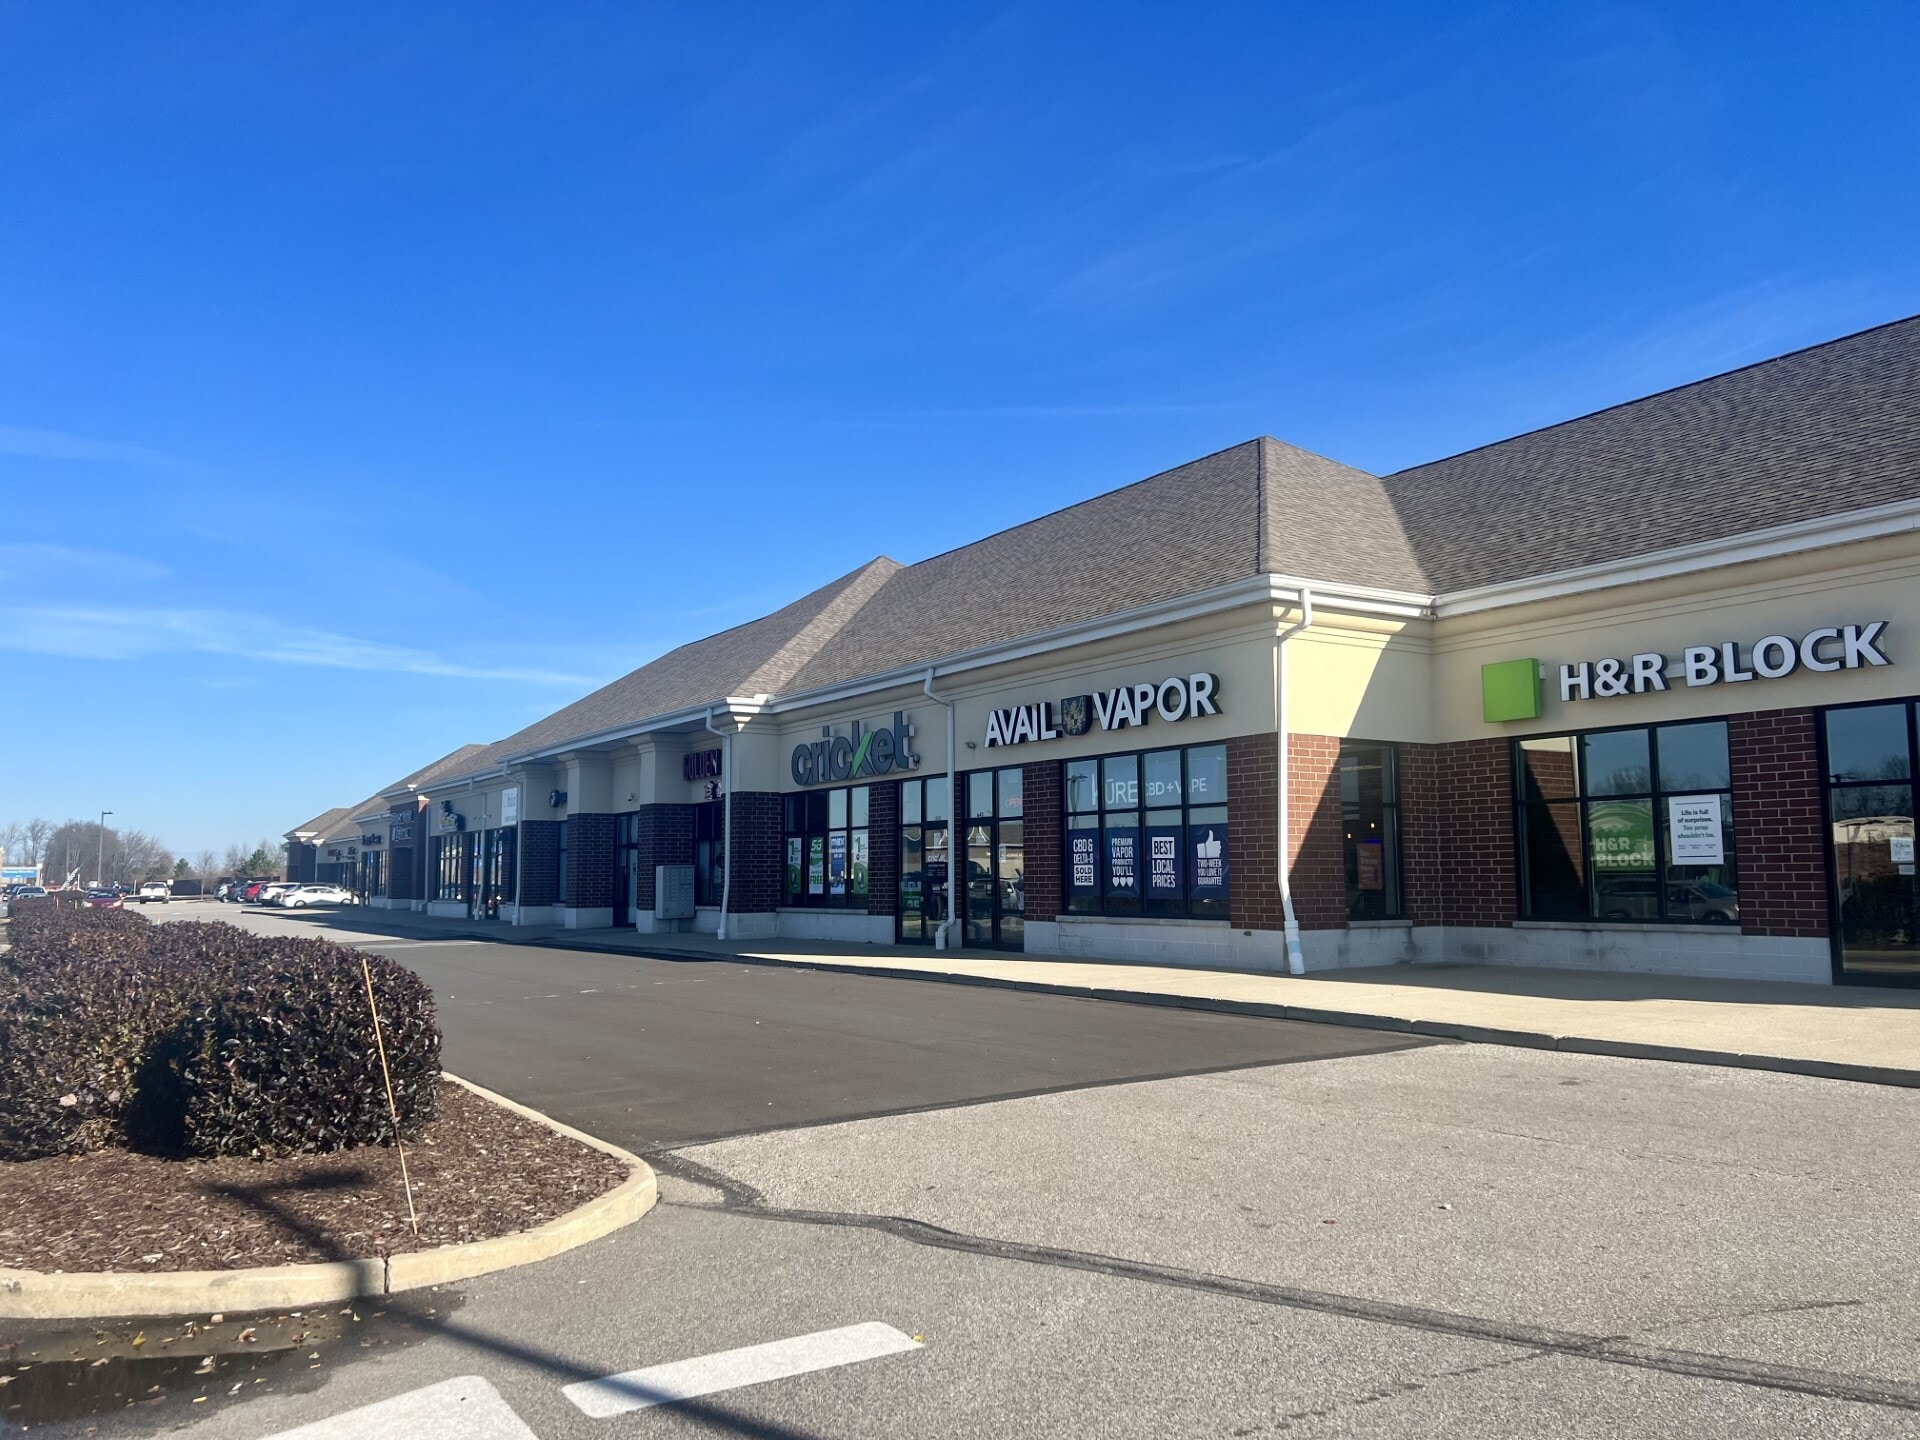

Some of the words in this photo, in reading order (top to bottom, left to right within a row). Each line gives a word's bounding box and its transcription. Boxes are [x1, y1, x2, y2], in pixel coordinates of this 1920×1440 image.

[1559, 652, 1669, 702] H&R
[1684, 620, 1893, 688] BLOCK
[984, 702, 1057, 748] AVAIL
[1092, 672, 1219, 731] VAPOR
[791, 711, 912, 786] cricket
[1073, 838, 1087, 852] CBD
[1111, 837, 1133, 846] PREMIUM
[1153, 840, 1173, 855] BEST
[1595, 836, 1631, 851] H&R
[1111, 846, 1133, 858] VAPOR
[1596, 852, 1655, 867] BLOCK
[1075, 867, 1092, 875] SOLD
[1152, 859, 1175, 874] LOCAL
[1075, 875, 1092, 884] HERE
[1152, 874, 1175, 888] PRICES
